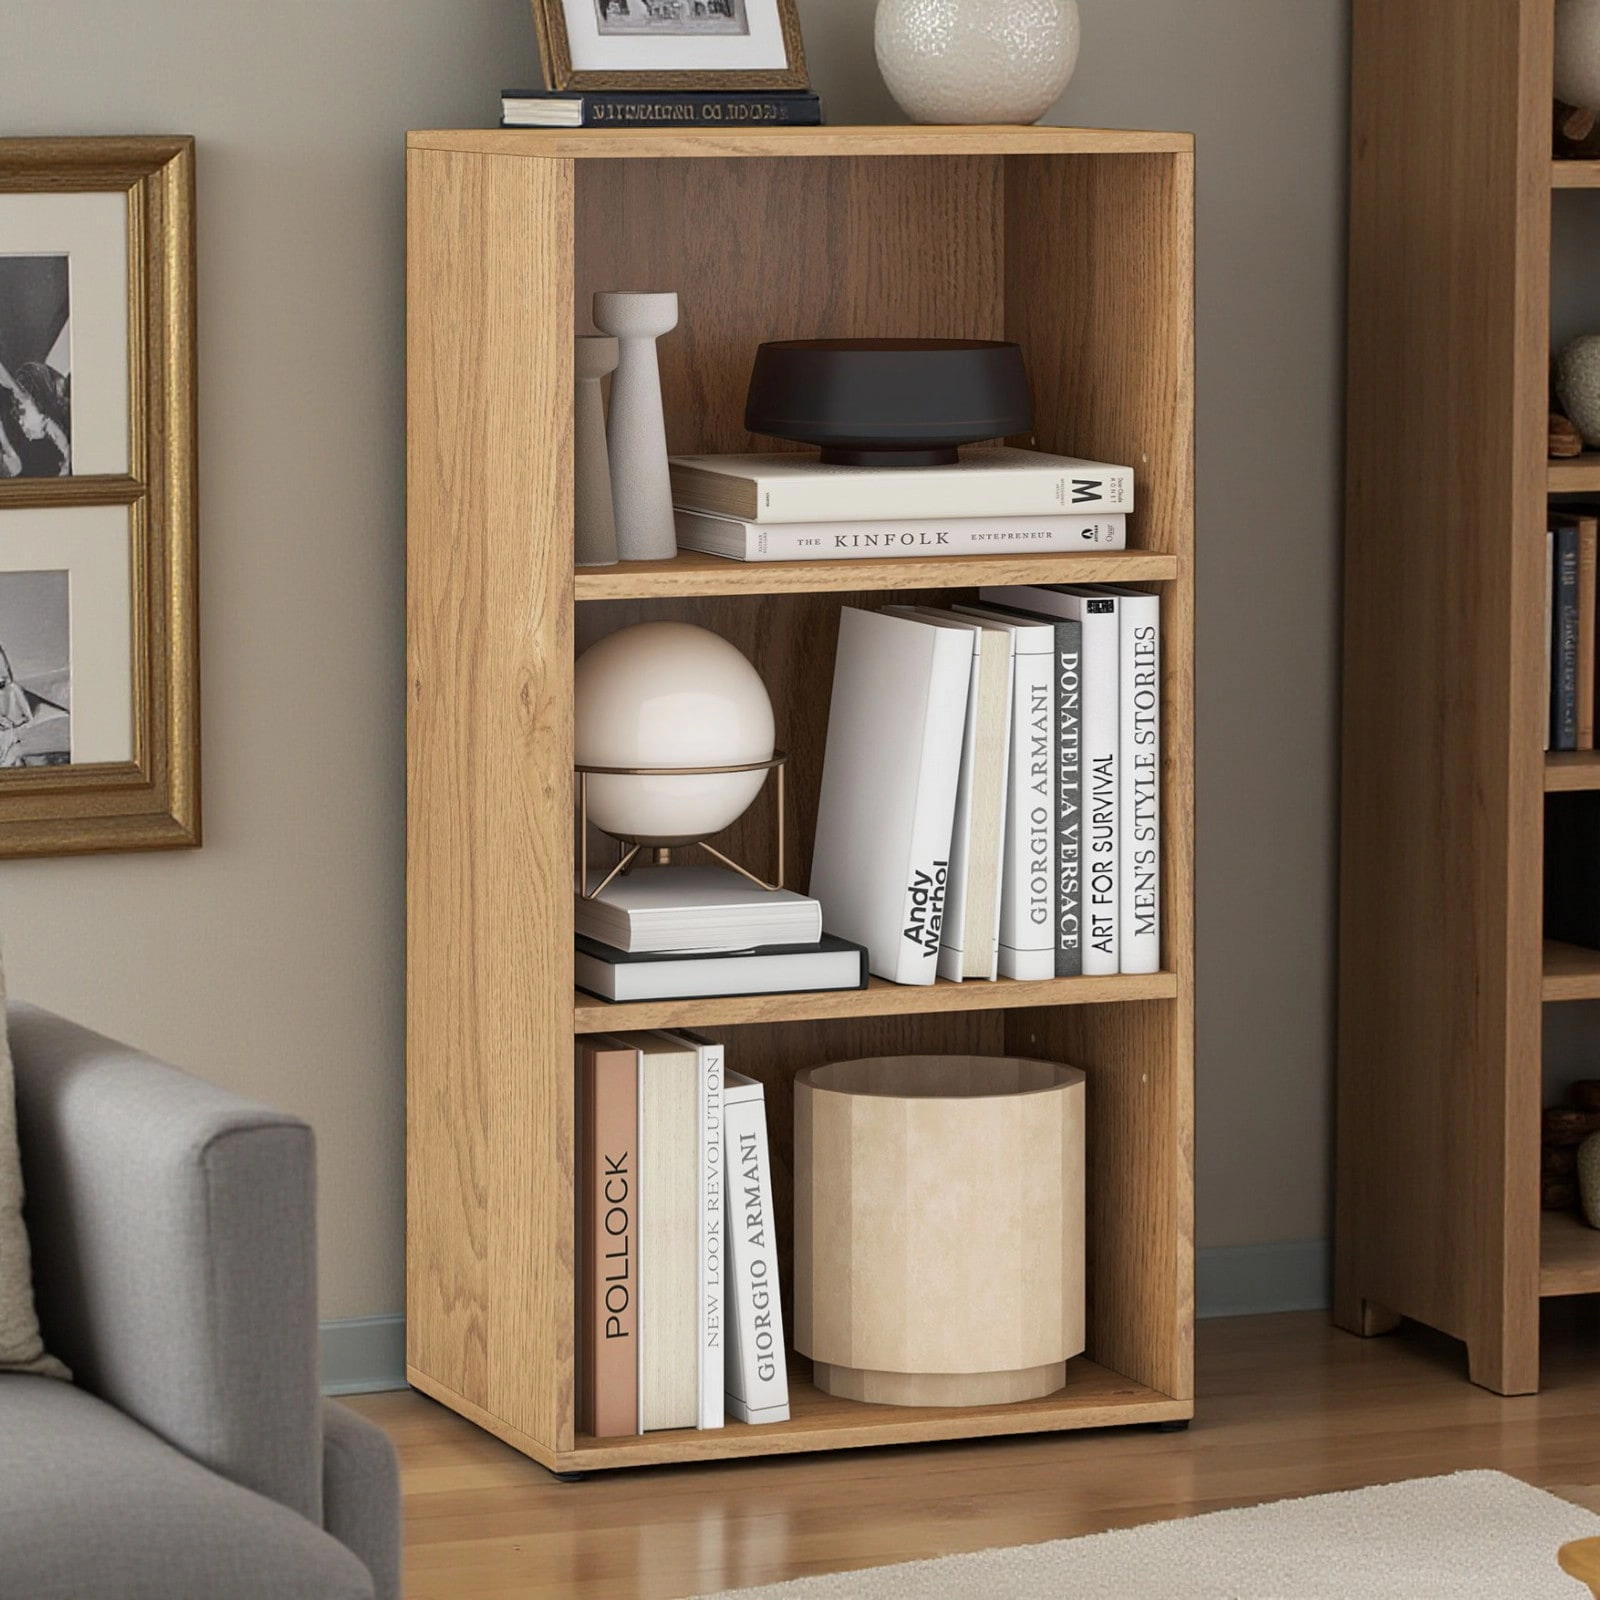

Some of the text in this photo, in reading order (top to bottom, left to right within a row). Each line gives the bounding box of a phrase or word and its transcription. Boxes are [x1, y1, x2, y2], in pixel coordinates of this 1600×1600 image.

[796, 531, 1052, 548] THE KINFOLK ENTEPRENEUR
[1071, 479, 1103, 504] M
[1030, 684, 1048, 925] GIORGIO ARMANI
[1060, 651, 1079, 951] DONATELLA VERSACE
[1091, 753, 1114, 954] ART FOR SURVIVAL
[1133, 626, 1156, 938] MEN'S STYLE STORIES
[903, 869, 933, 945] Andy
[923, 860, 948, 958] Warhol
[604, 1151, 629, 1339] POLLOCK
[707, 1057, 720, 1348] NEW LOOK REVOLUTION
[739, 1131, 775, 1382] GIORGIO ARMANI
